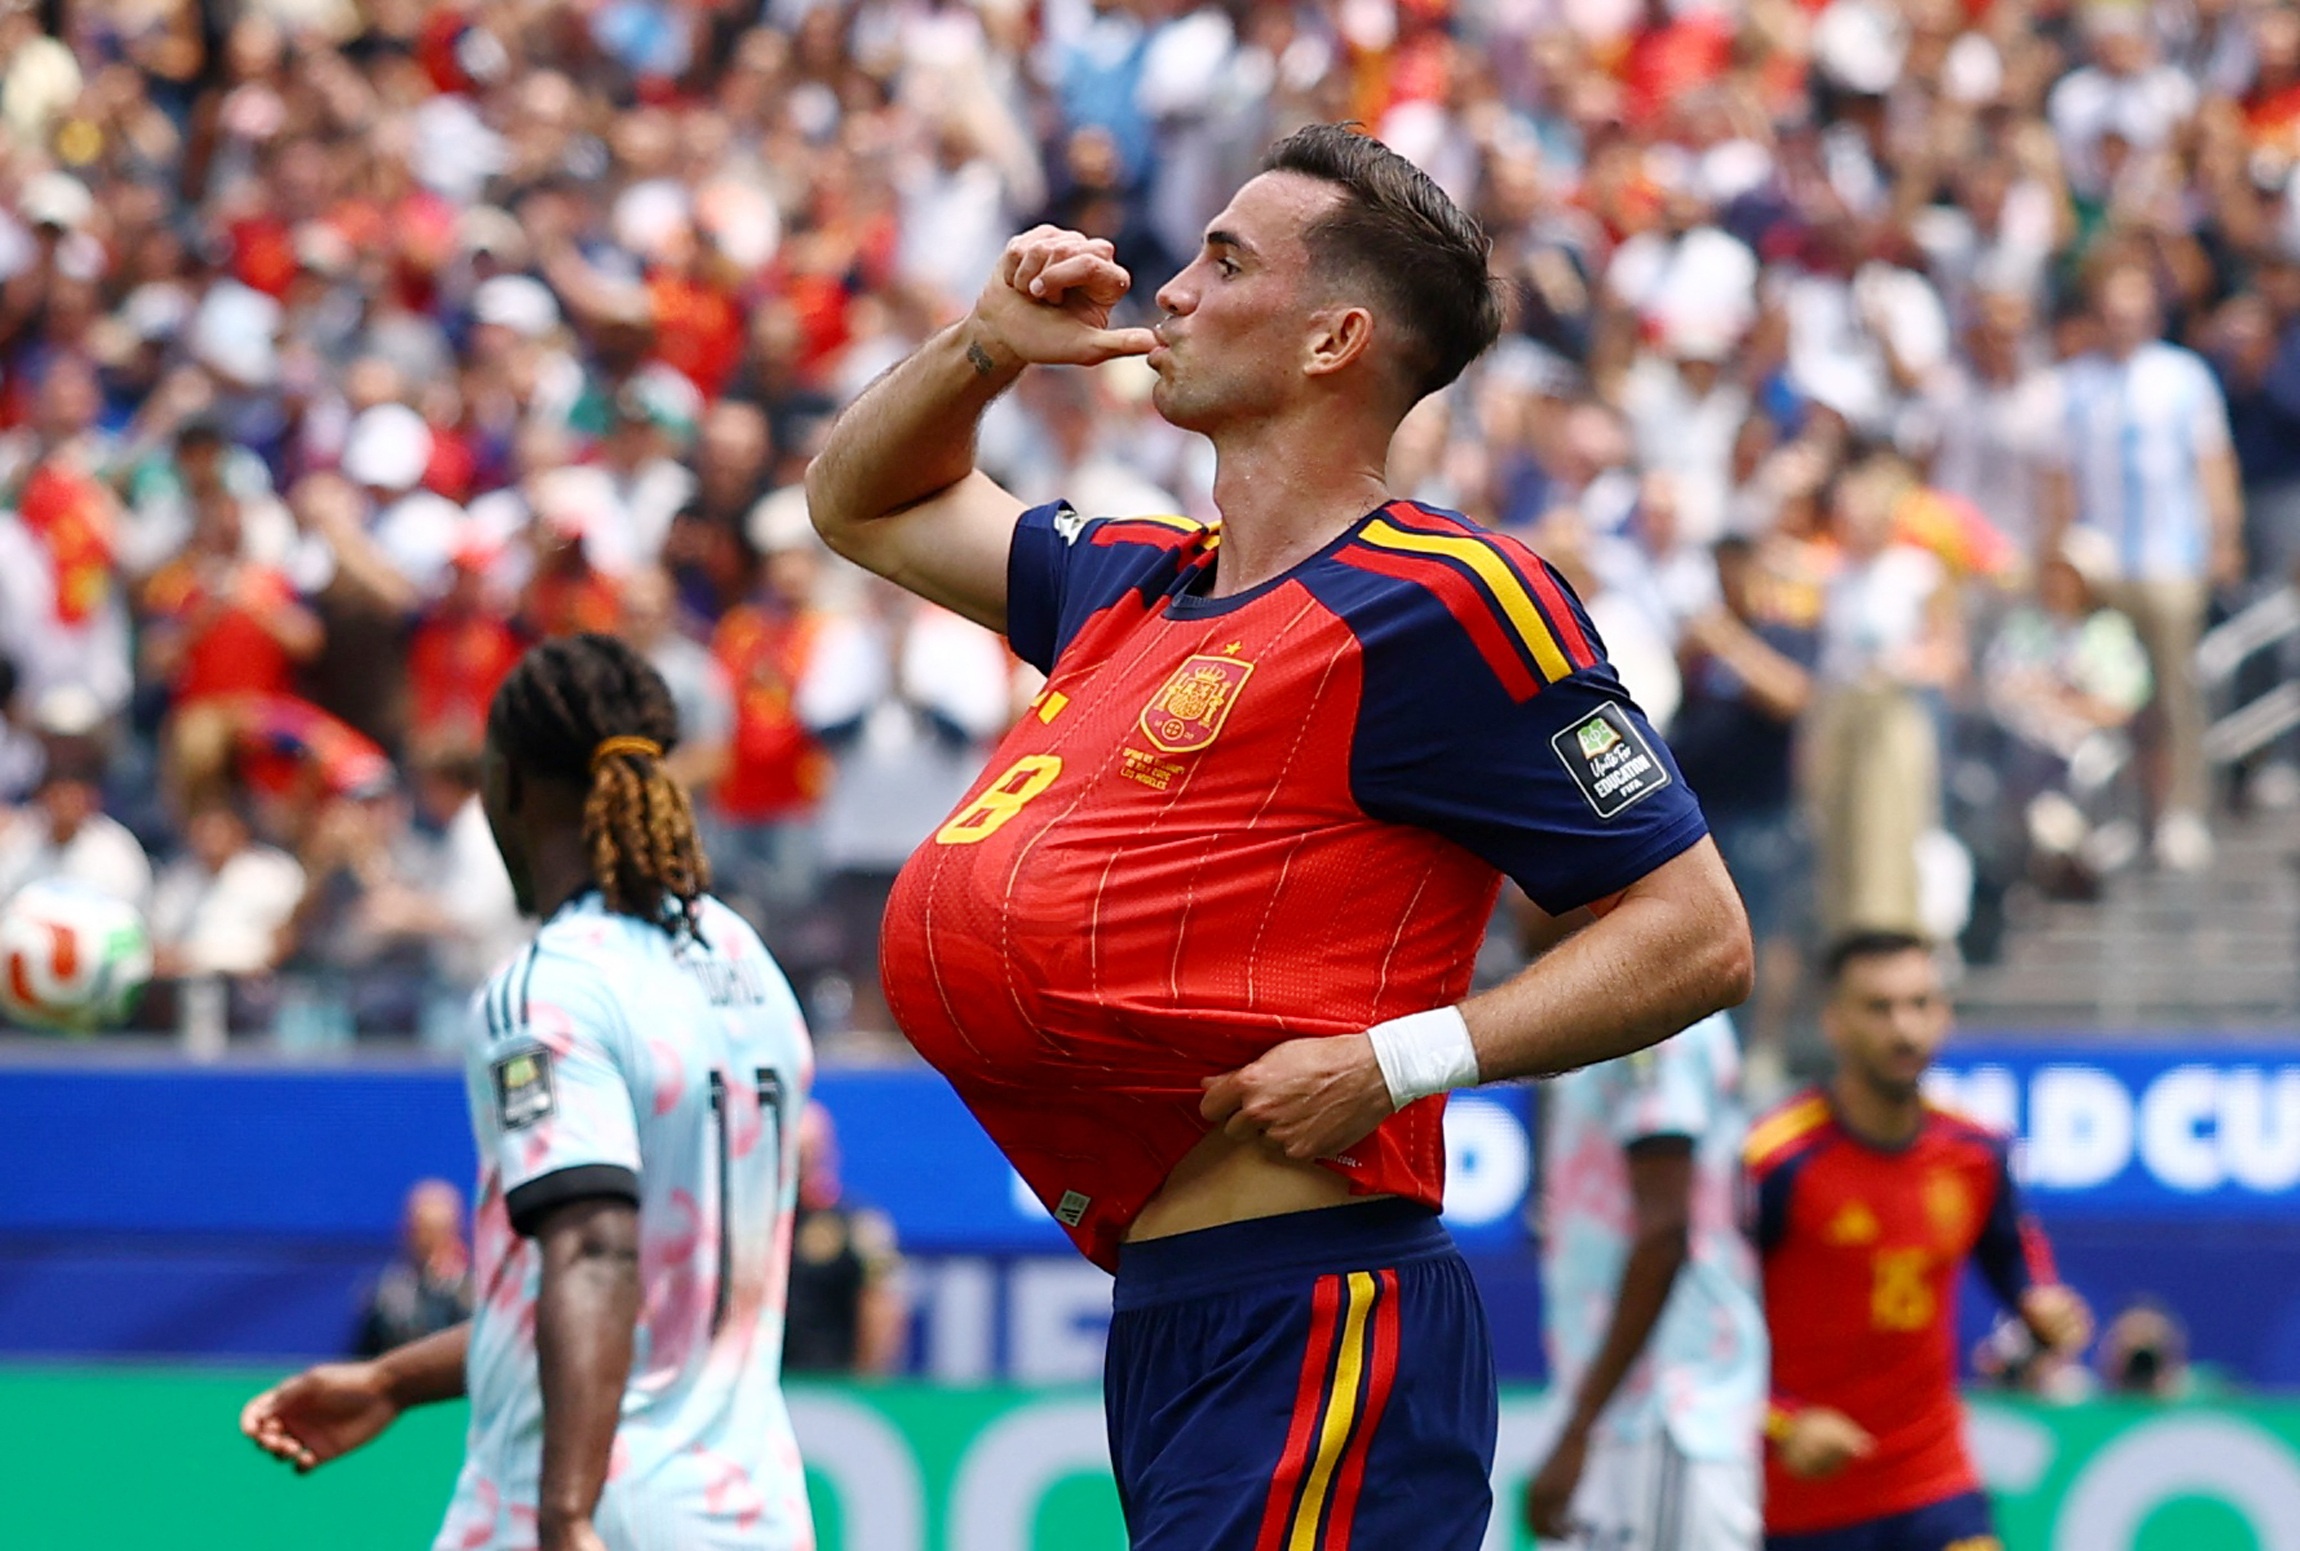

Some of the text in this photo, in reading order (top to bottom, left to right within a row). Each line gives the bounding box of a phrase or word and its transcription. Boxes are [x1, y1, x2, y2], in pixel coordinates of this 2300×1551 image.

[1613, 743, 1632, 762] For
[1593, 754, 1652, 798] EDUCATION
[1620, 779, 1644, 798] FIFA
[936, 755, 1062, 845] 8
